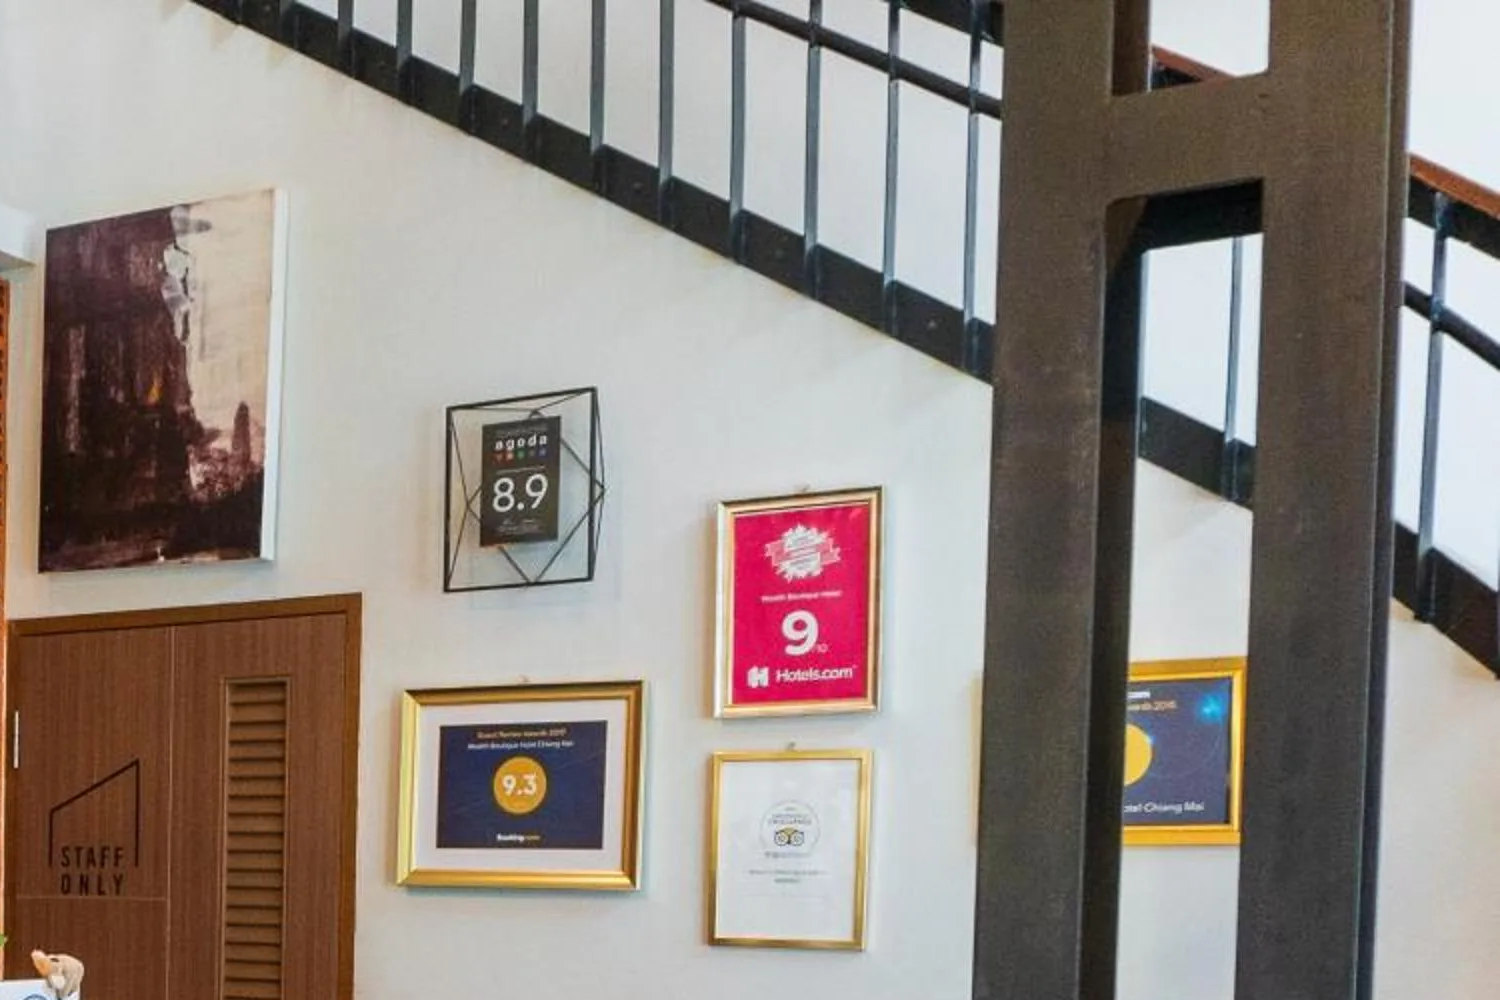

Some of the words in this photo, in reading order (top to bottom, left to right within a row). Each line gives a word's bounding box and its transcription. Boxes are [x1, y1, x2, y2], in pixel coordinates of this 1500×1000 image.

[495, 434, 547, 451] agoda
[492, 473, 548, 513] 8.9
[781, 609, 819, 656] 9
[775, 667, 854, 684] Hotels.com
[502, 773, 538, 797] 9.3
[60, 846, 124, 869] STAFF
[60, 873, 124, 897] ONLY
